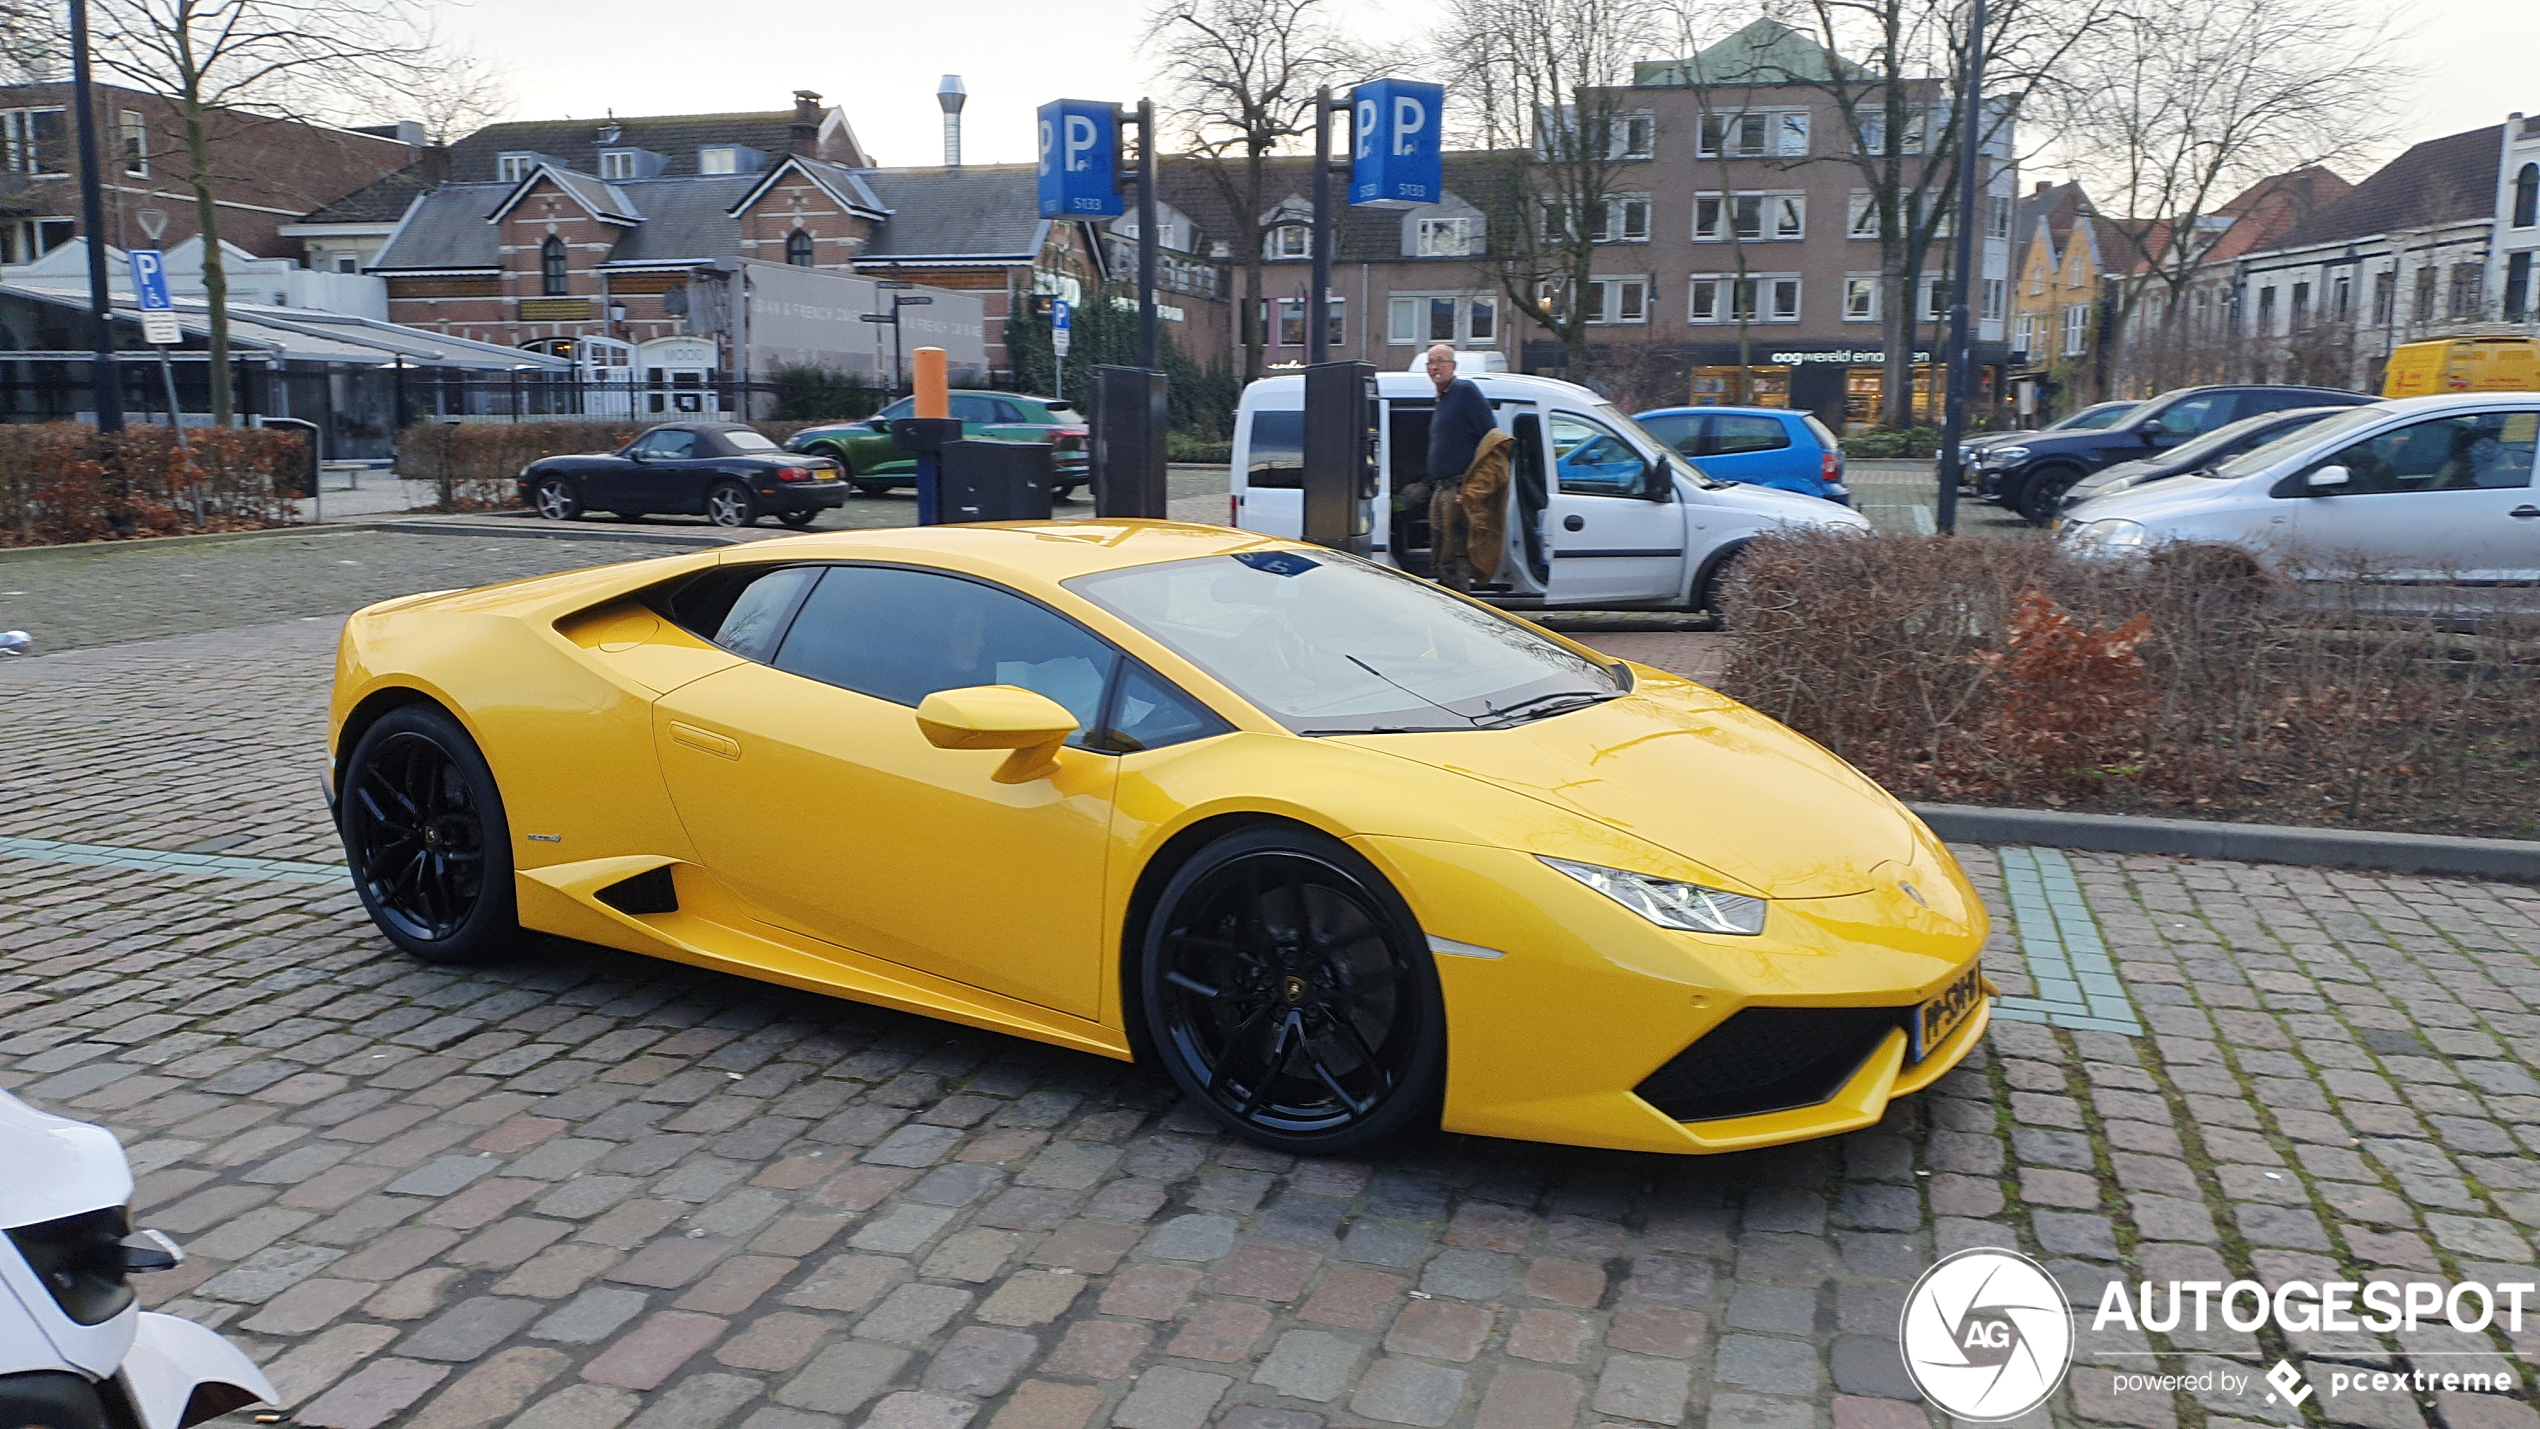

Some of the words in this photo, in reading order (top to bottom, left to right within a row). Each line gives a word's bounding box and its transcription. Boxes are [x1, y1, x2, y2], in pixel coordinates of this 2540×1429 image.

[1357, 99, 1378, 160] P
[1393, 96, 1426, 156] P
[1064, 114, 1098, 172] P
[1073, 197, 1102, 211] 5133
[136, 254, 158, 285] P
[1056, 303, 1067, 326] P
[1771, 349, 1851, 366] oogwereld
